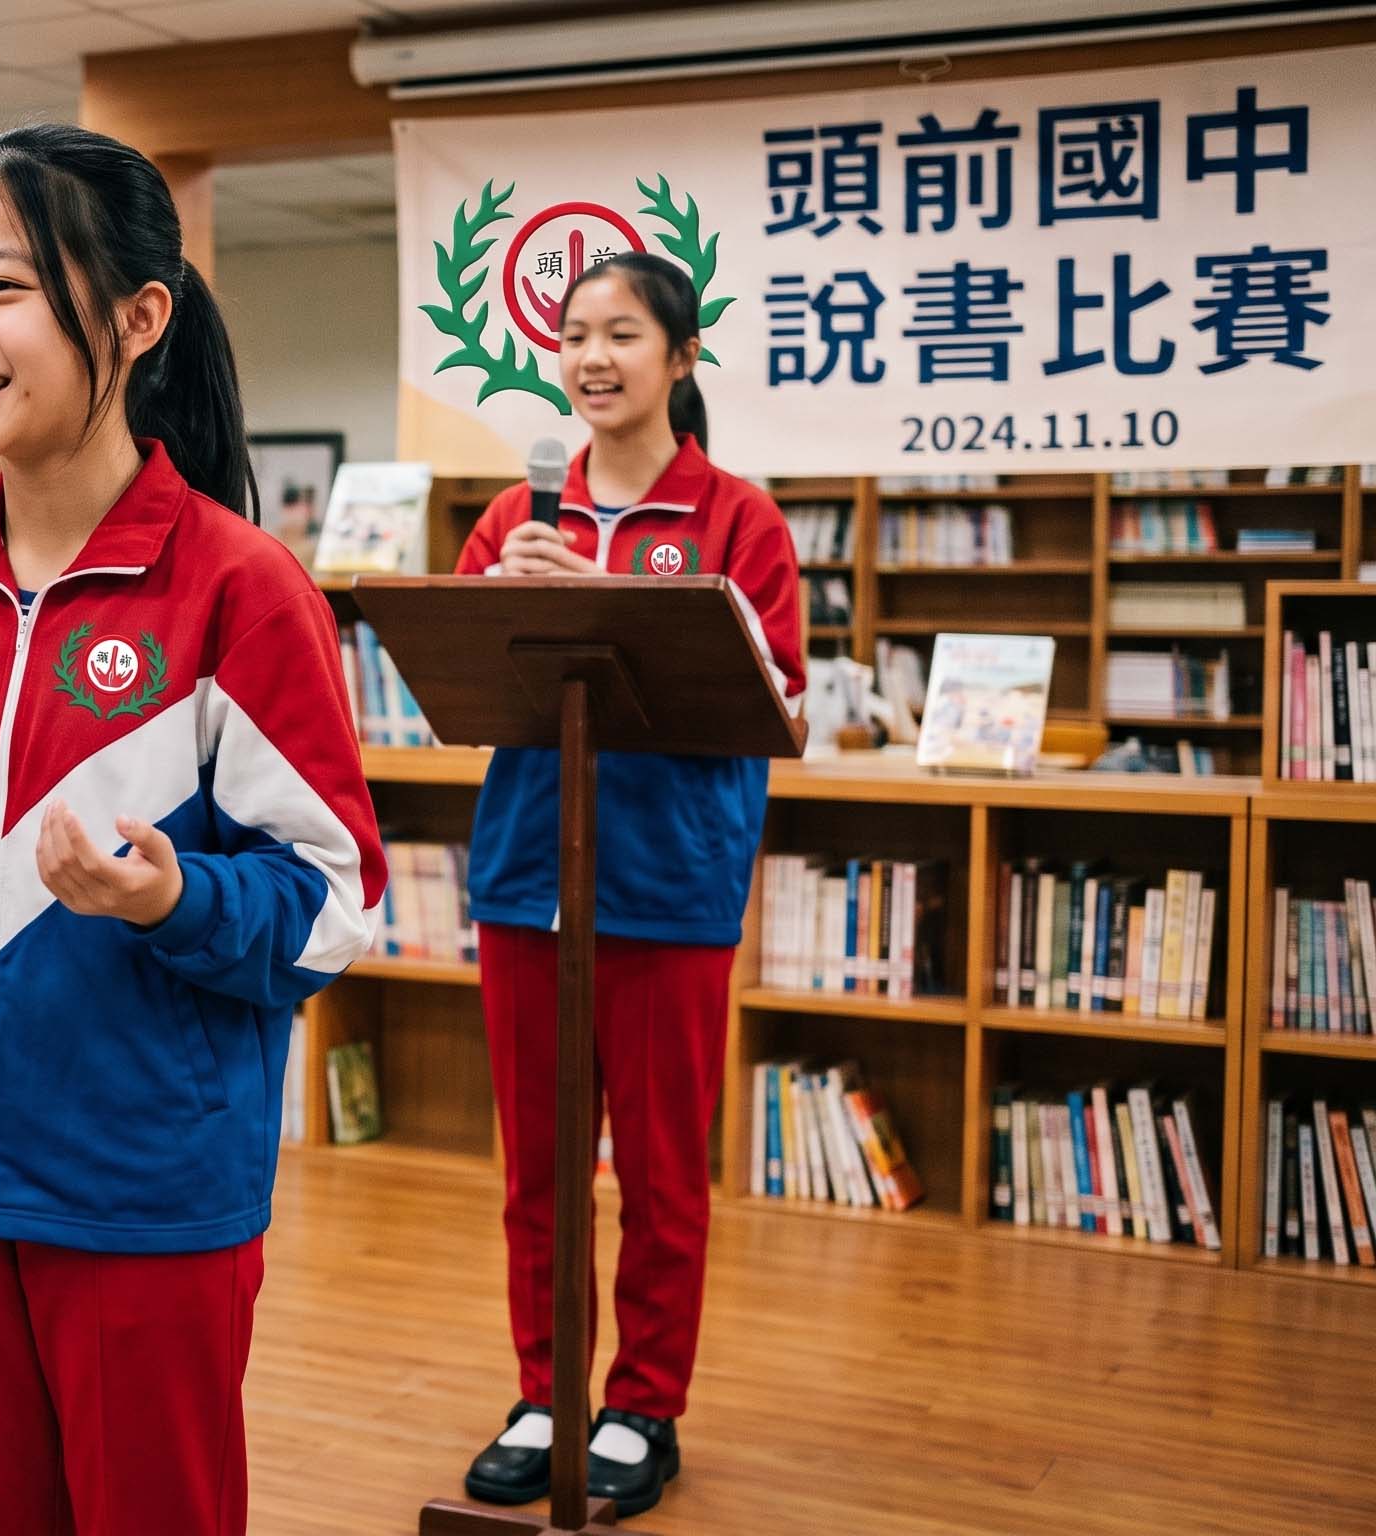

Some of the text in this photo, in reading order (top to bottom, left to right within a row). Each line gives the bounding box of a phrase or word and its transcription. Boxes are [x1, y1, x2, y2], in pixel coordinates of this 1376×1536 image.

[762, 86, 1311, 238] 頭前國中
[763, 244, 1332, 388] 說書比賽
[900, 409, 1180, 454] 2024.11.10
